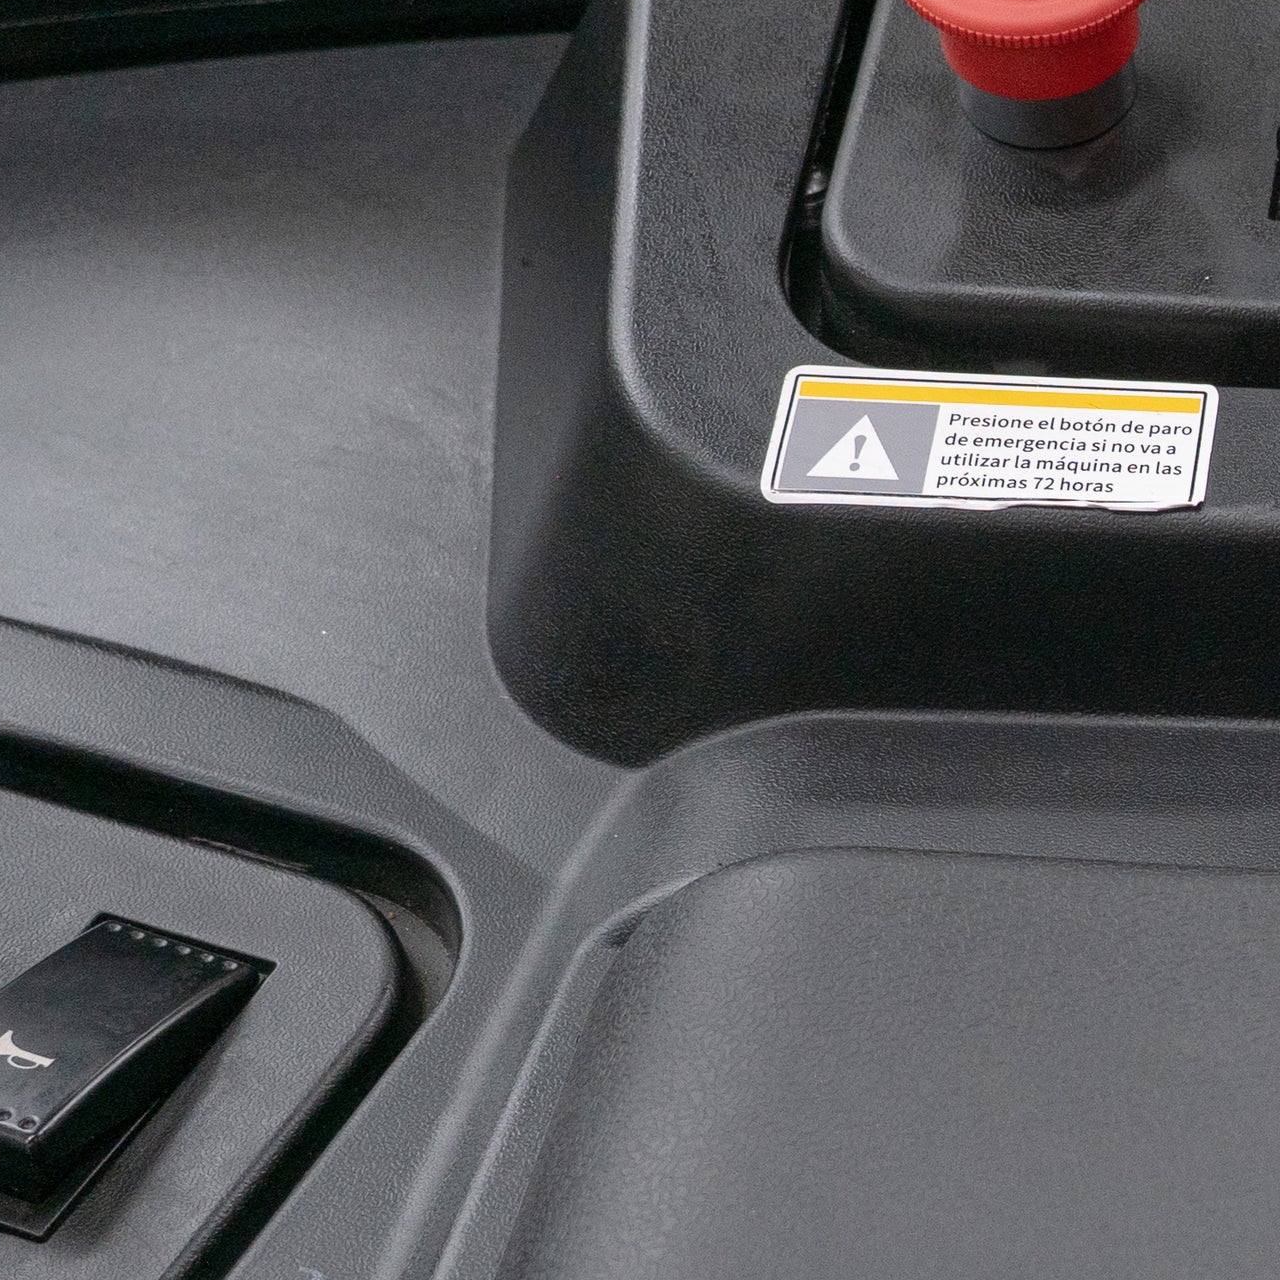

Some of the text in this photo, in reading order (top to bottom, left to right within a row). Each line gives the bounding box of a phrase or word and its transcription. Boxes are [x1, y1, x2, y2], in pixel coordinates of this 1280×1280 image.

[948, 413, 1193, 437] Presione el botón de paro
[944, 432, 1177, 455] de emergencia si no va a
[940, 453, 1183, 476] utilizar la máquina en las
[936, 472, 1114, 493] próximas 72 horas
